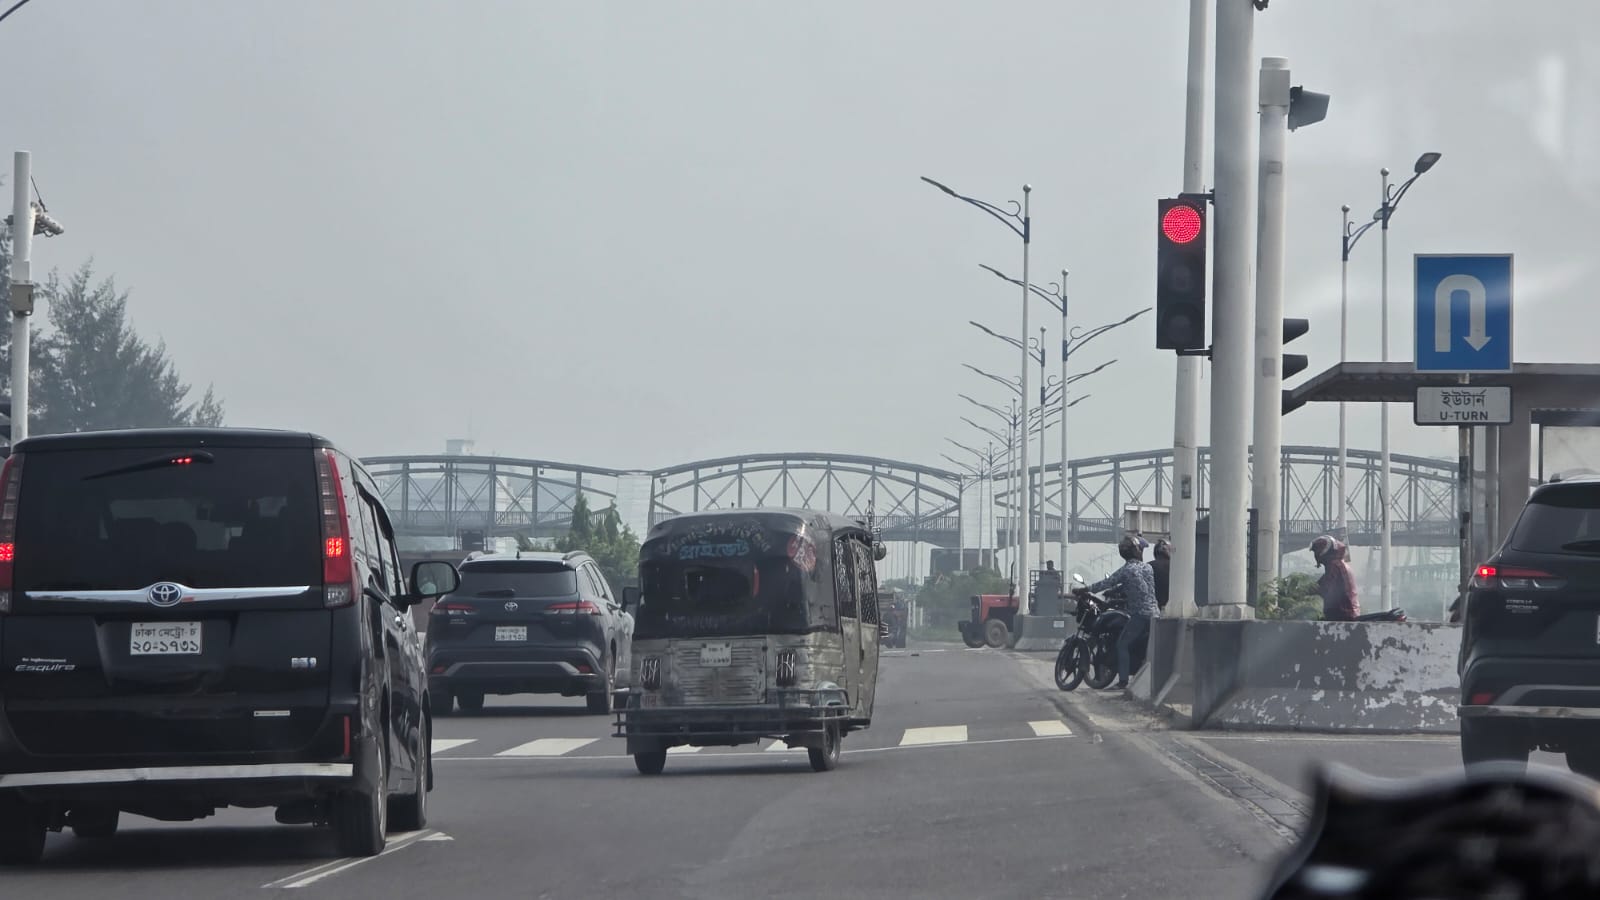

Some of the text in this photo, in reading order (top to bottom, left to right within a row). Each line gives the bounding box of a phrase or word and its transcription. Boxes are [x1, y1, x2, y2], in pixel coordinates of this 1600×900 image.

[1440, 388, 1487, 408] ইউটার্ন
[1440, 411, 1488, 421] U-TURN
[135, 628, 156, 638] ঢাকা
[15, 663, 76, 672] Esquire
